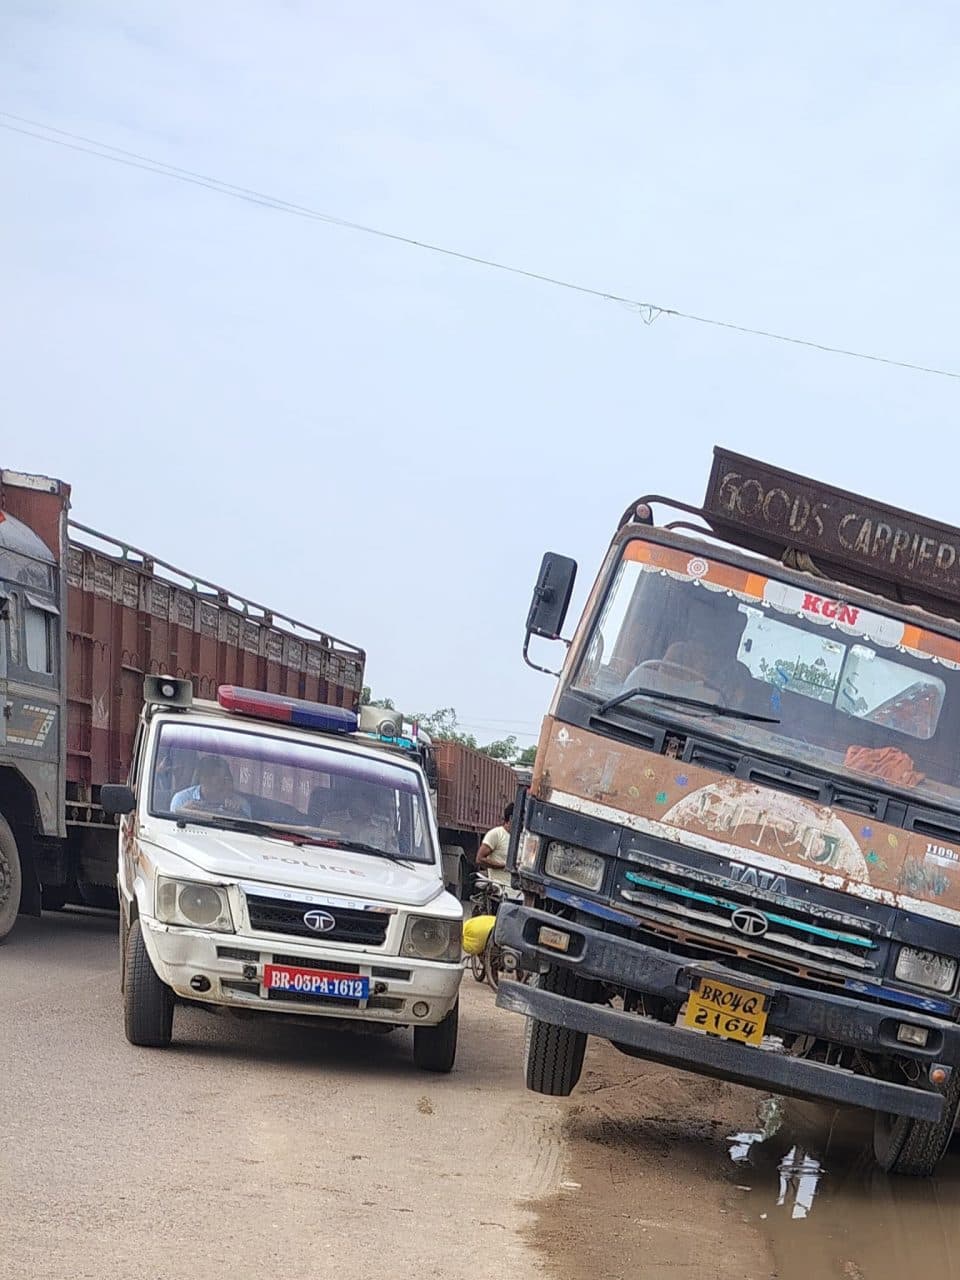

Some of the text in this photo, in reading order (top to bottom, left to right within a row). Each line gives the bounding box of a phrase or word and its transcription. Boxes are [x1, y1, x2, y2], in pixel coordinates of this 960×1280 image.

[801, 593, 860, 625] KGN
[262, 854, 366, 878] POLICE
[729, 862, 788, 895] TATA
[271, 970, 363, 997] BR-03PA-1612
[701, 985, 760, 1016] BR04Q
[694, 1007, 759, 1038] 2164
